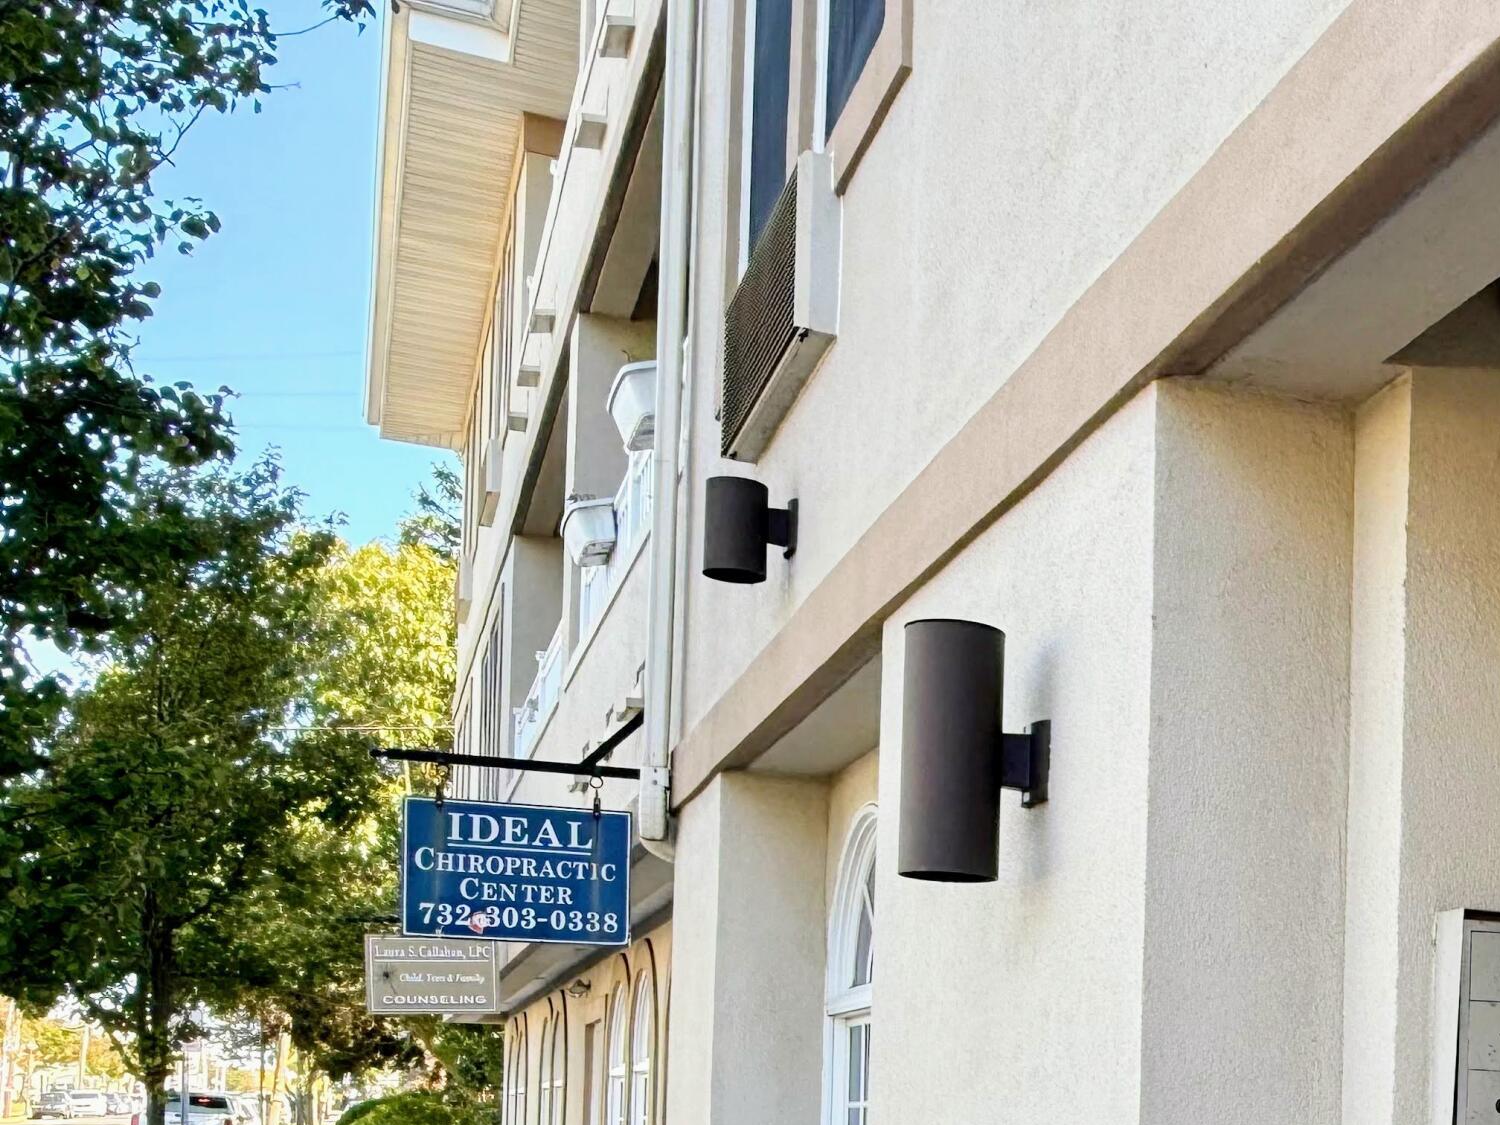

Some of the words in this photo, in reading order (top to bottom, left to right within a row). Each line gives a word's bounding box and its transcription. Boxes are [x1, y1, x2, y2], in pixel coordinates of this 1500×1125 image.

[447, 811, 593, 849] IDEAL
[414, 846, 617, 882] CHIROPRACTIC
[459, 877, 573, 905] CENTER
[468, 945, 492, 958] LPC
[382, 995, 487, 1005] COUNSELING
